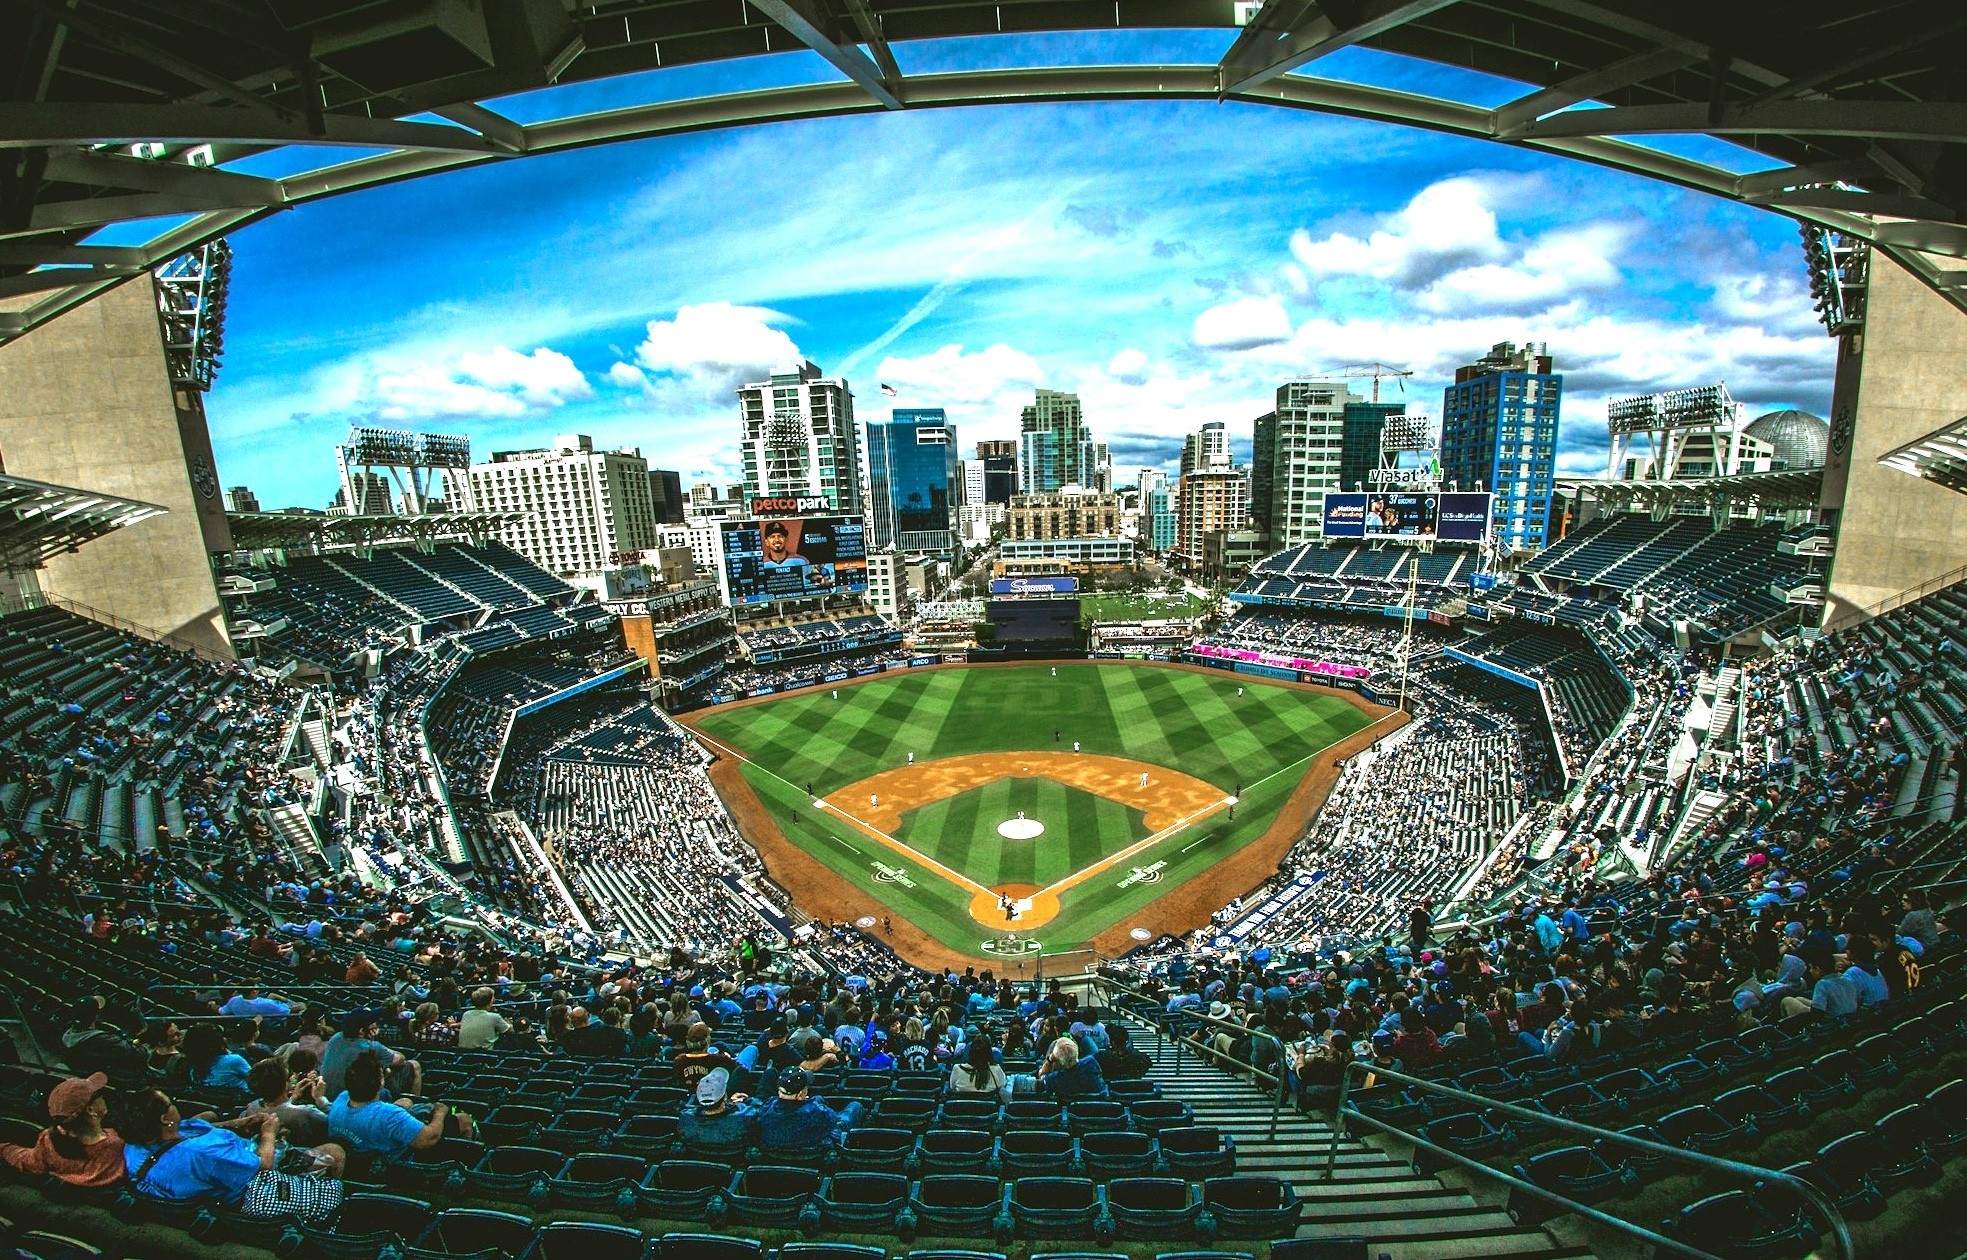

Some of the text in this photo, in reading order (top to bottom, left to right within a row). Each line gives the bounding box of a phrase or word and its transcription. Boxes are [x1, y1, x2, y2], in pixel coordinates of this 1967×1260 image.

[1370, 468, 1418, 482] Viasat
[804, 533, 810, 544] 5
[648, 596, 674, 610] WESTERN
[674, 592, 691, 604] METAL
[691, 587, 709, 600] SUPPLY
[825, 672, 848, 682] GEICO
[785, 680, 815, 690] Qualcomm
[903, 1044, 930, 1058] MACHADO
[908, 1055, 926, 1072] 13
